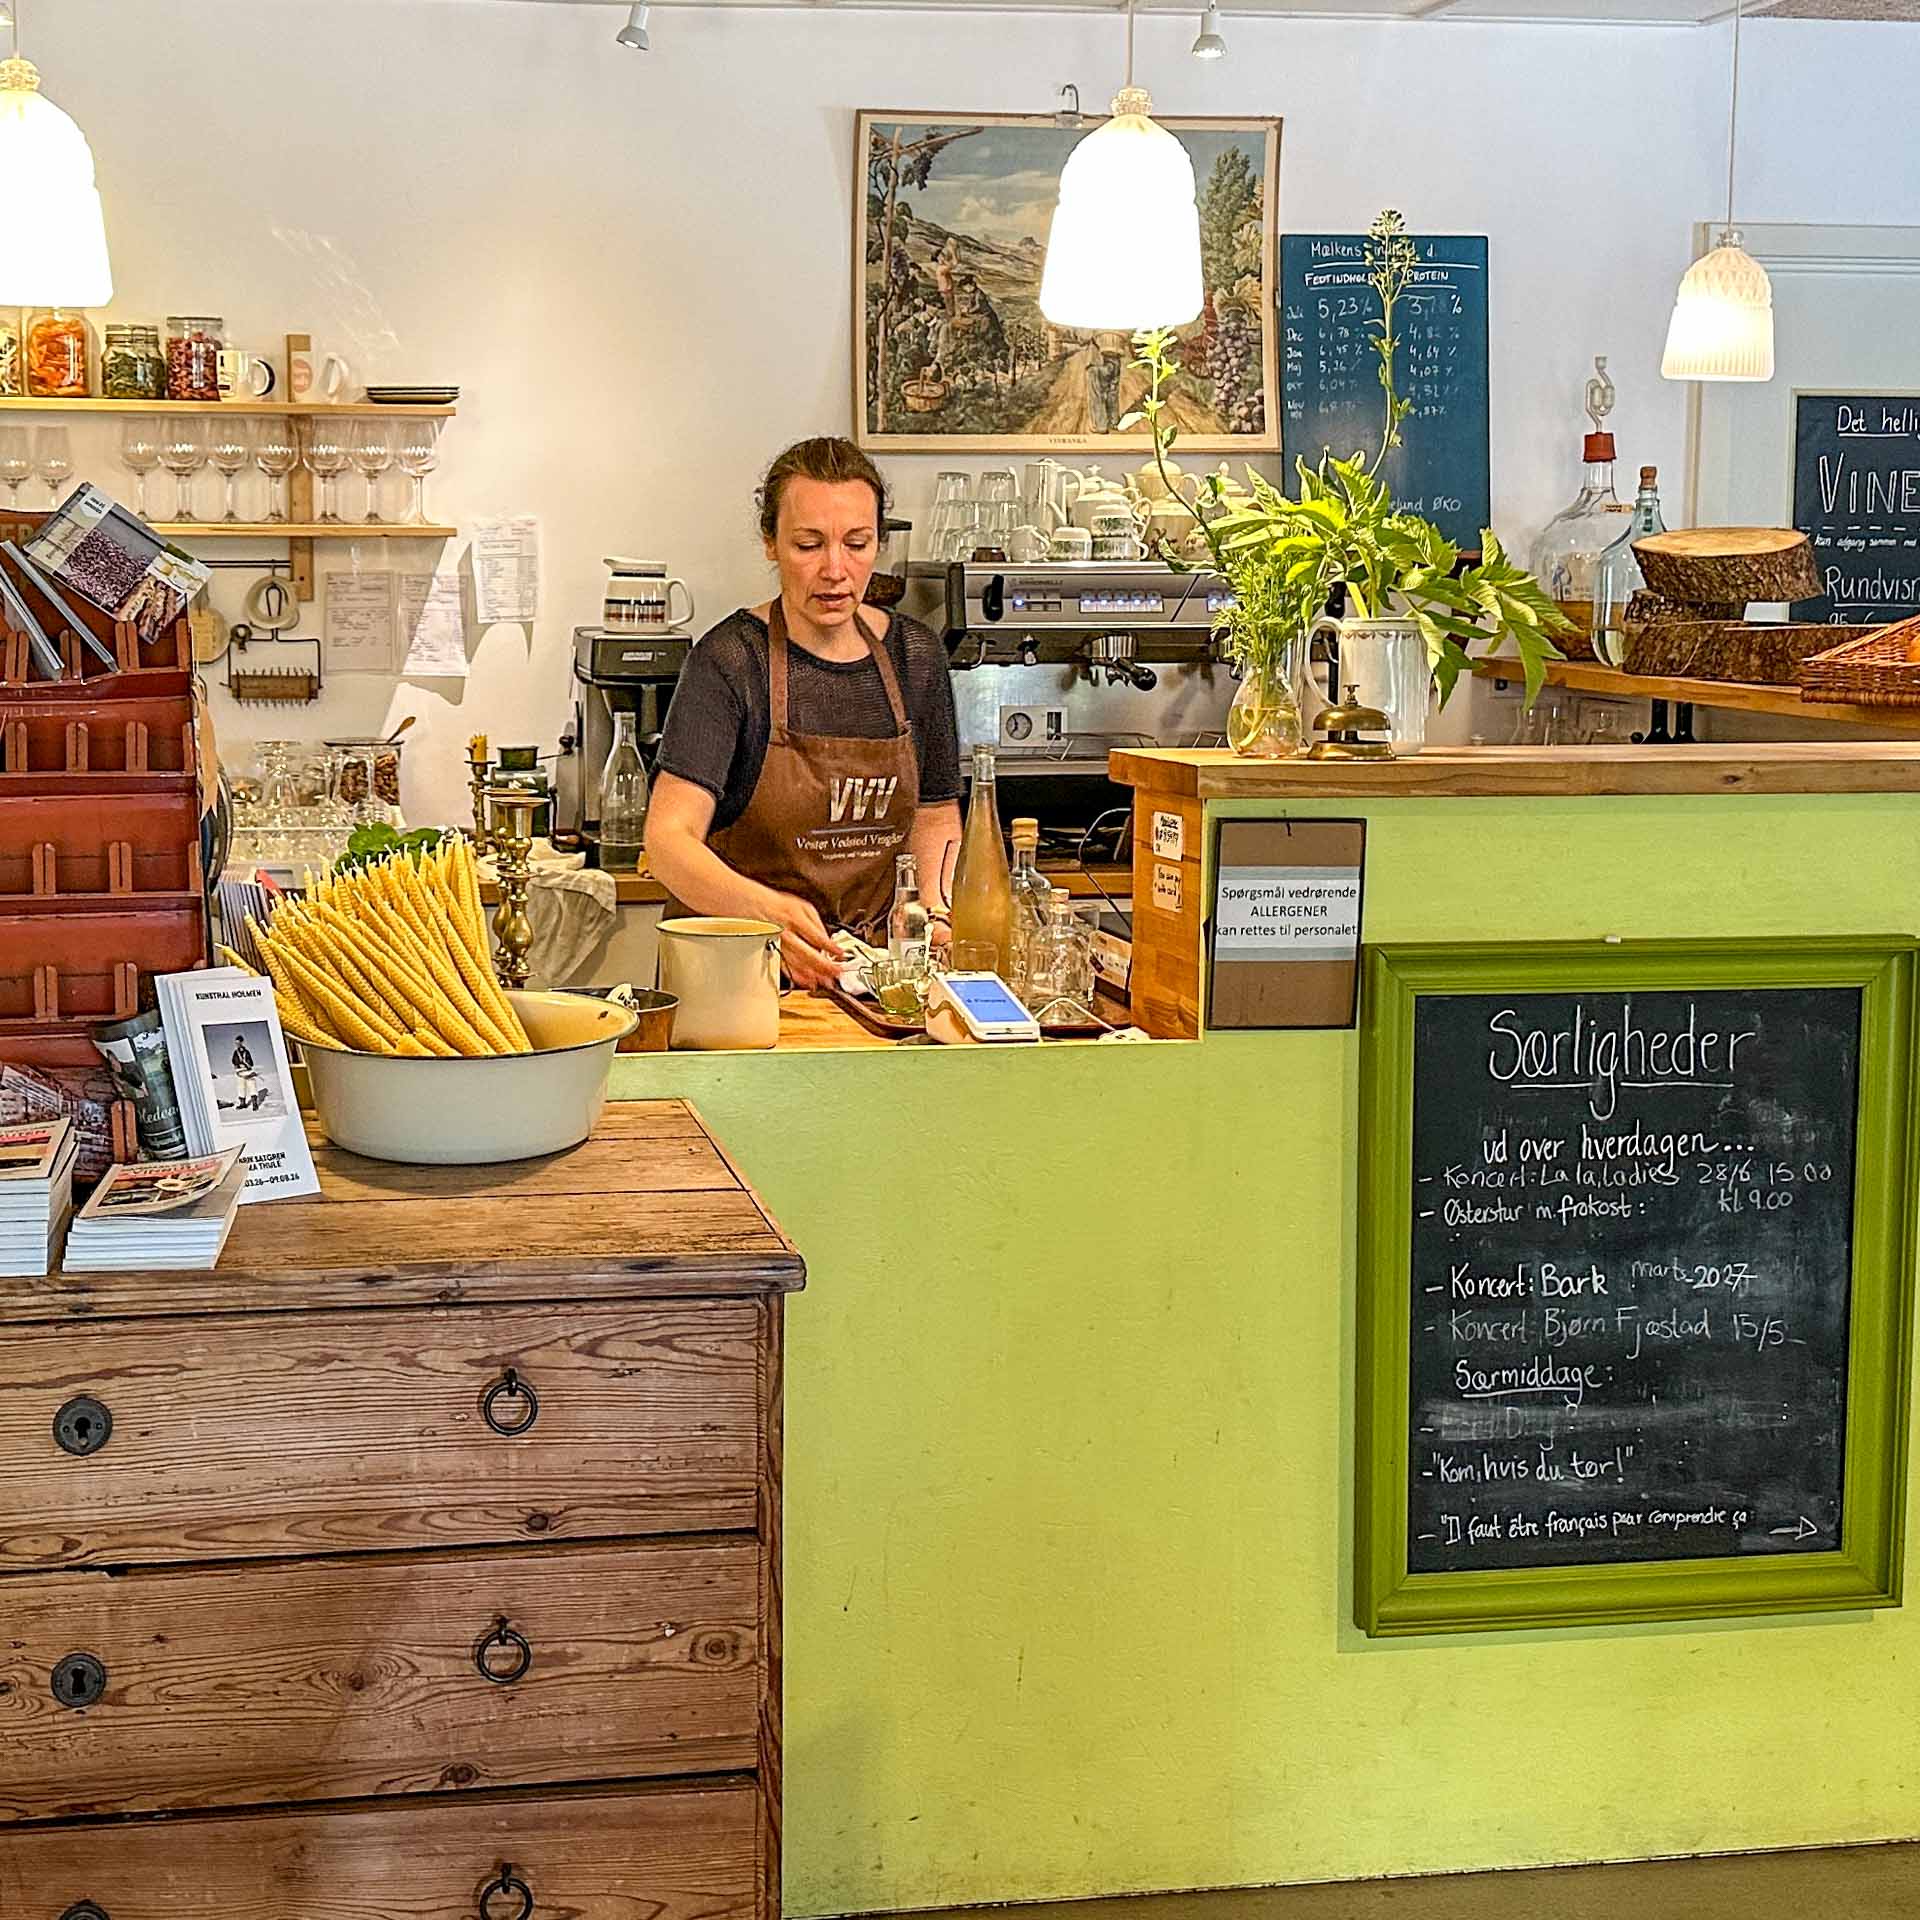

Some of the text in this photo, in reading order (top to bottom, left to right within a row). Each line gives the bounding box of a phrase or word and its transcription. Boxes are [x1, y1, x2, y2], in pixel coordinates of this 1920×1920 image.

[1311, 241, 1362, 258] Mælkens
[1406, 269, 1449, 282] PROTEIN
[1837, 405, 1920, 441] Det helli
[1221, 886, 1357, 900] Spørgsmål vedrørende
[1250, 905, 1328, 918] ALLERGENER
[1240, 925, 1276, 937] rettes
[1279, 924, 1291, 936] til
[1294, 924, 1357, 938] personalet
[1490, 1004, 1756, 1121] Særligheder
[1484, 1128, 1508, 1164] ud
[1520, 1137, 1565, 1162] over
[1540, 1263, 1609, 1298] Bark
[1535, 1451, 1565, 1482] du
[1467, 1514, 1502, 1545] faut
[1508, 1512, 1540, 1538] être
[1545, 1511, 1608, 1538] français
